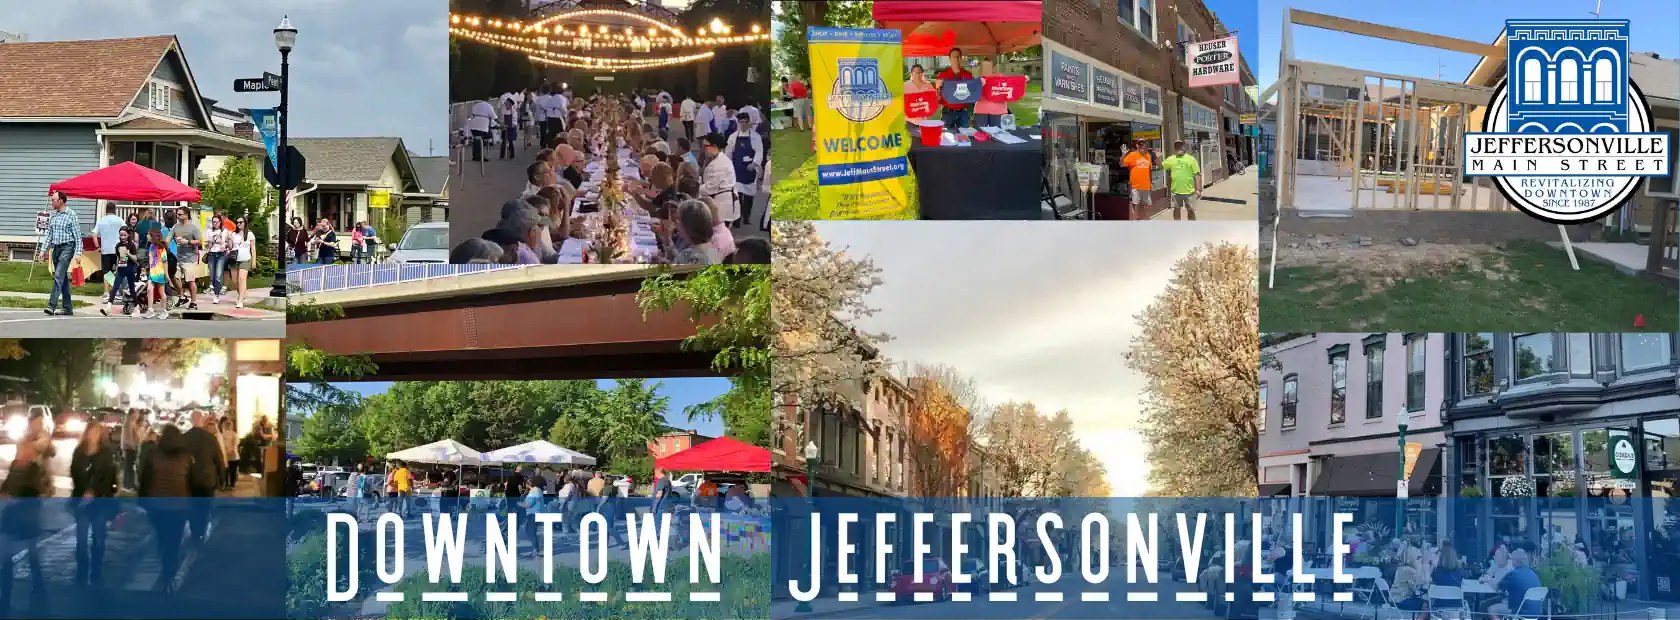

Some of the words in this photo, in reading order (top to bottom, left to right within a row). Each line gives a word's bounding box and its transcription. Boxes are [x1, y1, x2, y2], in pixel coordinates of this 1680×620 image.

[1199, 41, 1227, 51] HEUSER
[1192, 64, 1235, 76] HARDWARE
[823, 132, 902, 152] WELCOME
[822, 163, 905, 178] www.JeffMainStreet.org
